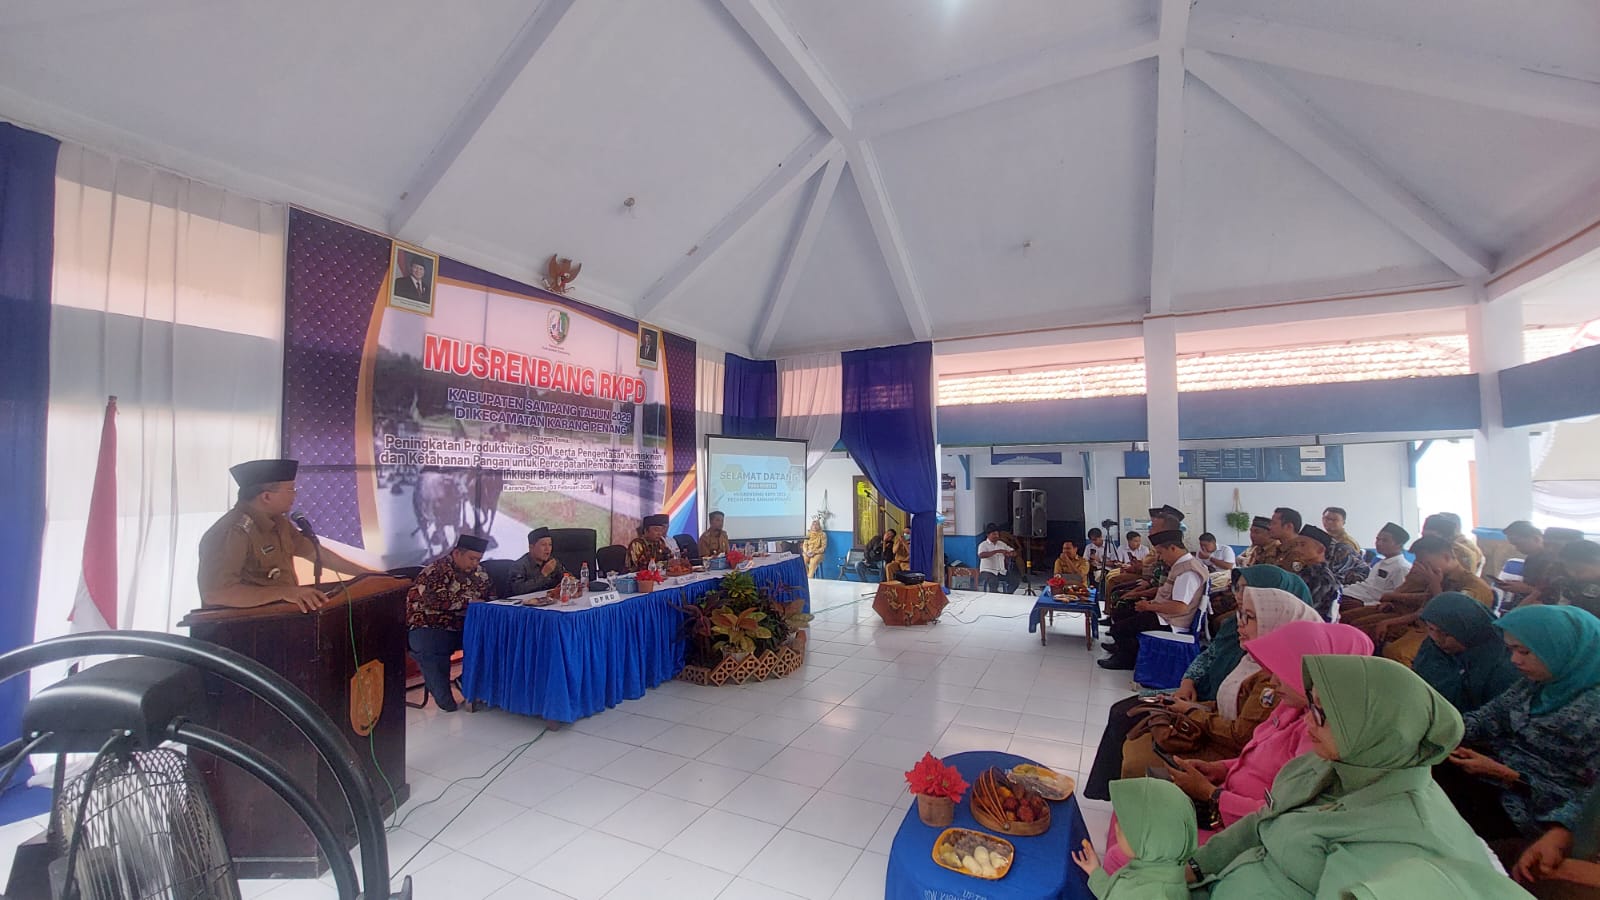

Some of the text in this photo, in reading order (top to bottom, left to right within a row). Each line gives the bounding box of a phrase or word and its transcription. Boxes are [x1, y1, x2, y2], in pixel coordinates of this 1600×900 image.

[424, 334, 647, 404] MUSRENBANG RKPD
[448, 388, 523, 409] KABUPATEN
[525, 399, 577, 417] SAMPANG
[579, 407, 610, 420] TAHUN
[547, 417, 589, 431] KARANG
[590, 422, 627, 435] PENANG
[385, 434, 461, 452] Peningkatan
[464, 440, 530, 455] Produktivitas
[531, 444, 553, 456] SDM
[554, 449, 576, 457] serta
[577, 447, 625, 460] Pengentasan
[380, 451, 407, 465] dan
[407, 451, 471, 466] Ketahanan
[472, 455, 511, 469] Pangan
[512, 458, 538, 468] untuk
[539, 457, 586, 470] Percepatan
[587, 460, 637, 472] Pembangunan
[503, 469, 594, 482] Inklusif Berkelanjutan
[720, 471, 762, 480] SELAMAT
